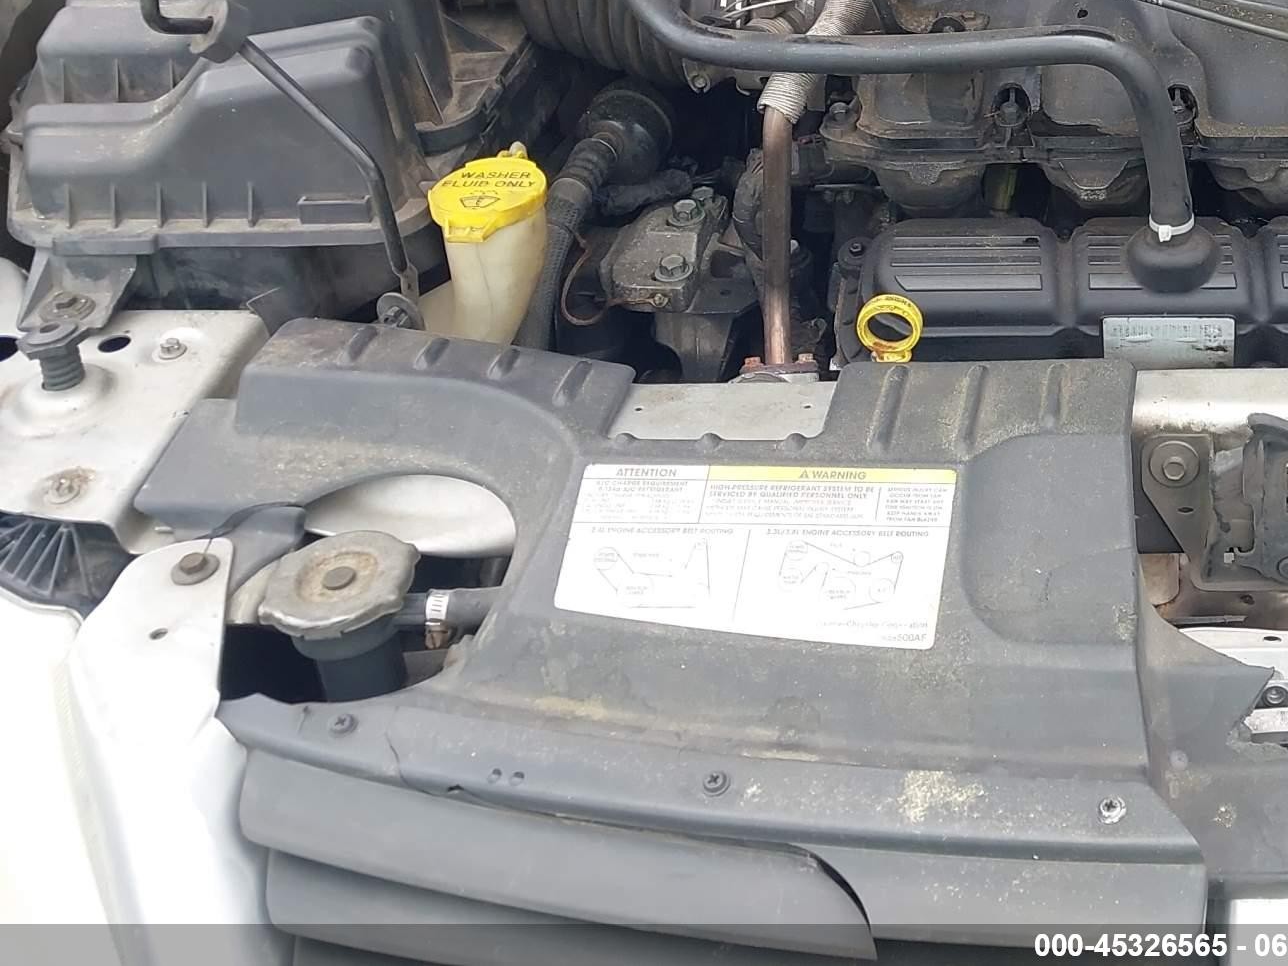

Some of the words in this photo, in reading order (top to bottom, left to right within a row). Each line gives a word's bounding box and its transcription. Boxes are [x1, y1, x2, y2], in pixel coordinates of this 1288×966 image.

[461, 171, 532, 179] WASHER
[616, 468, 678, 478] ATTENTION
[812, 470, 867, 480] WARNING
